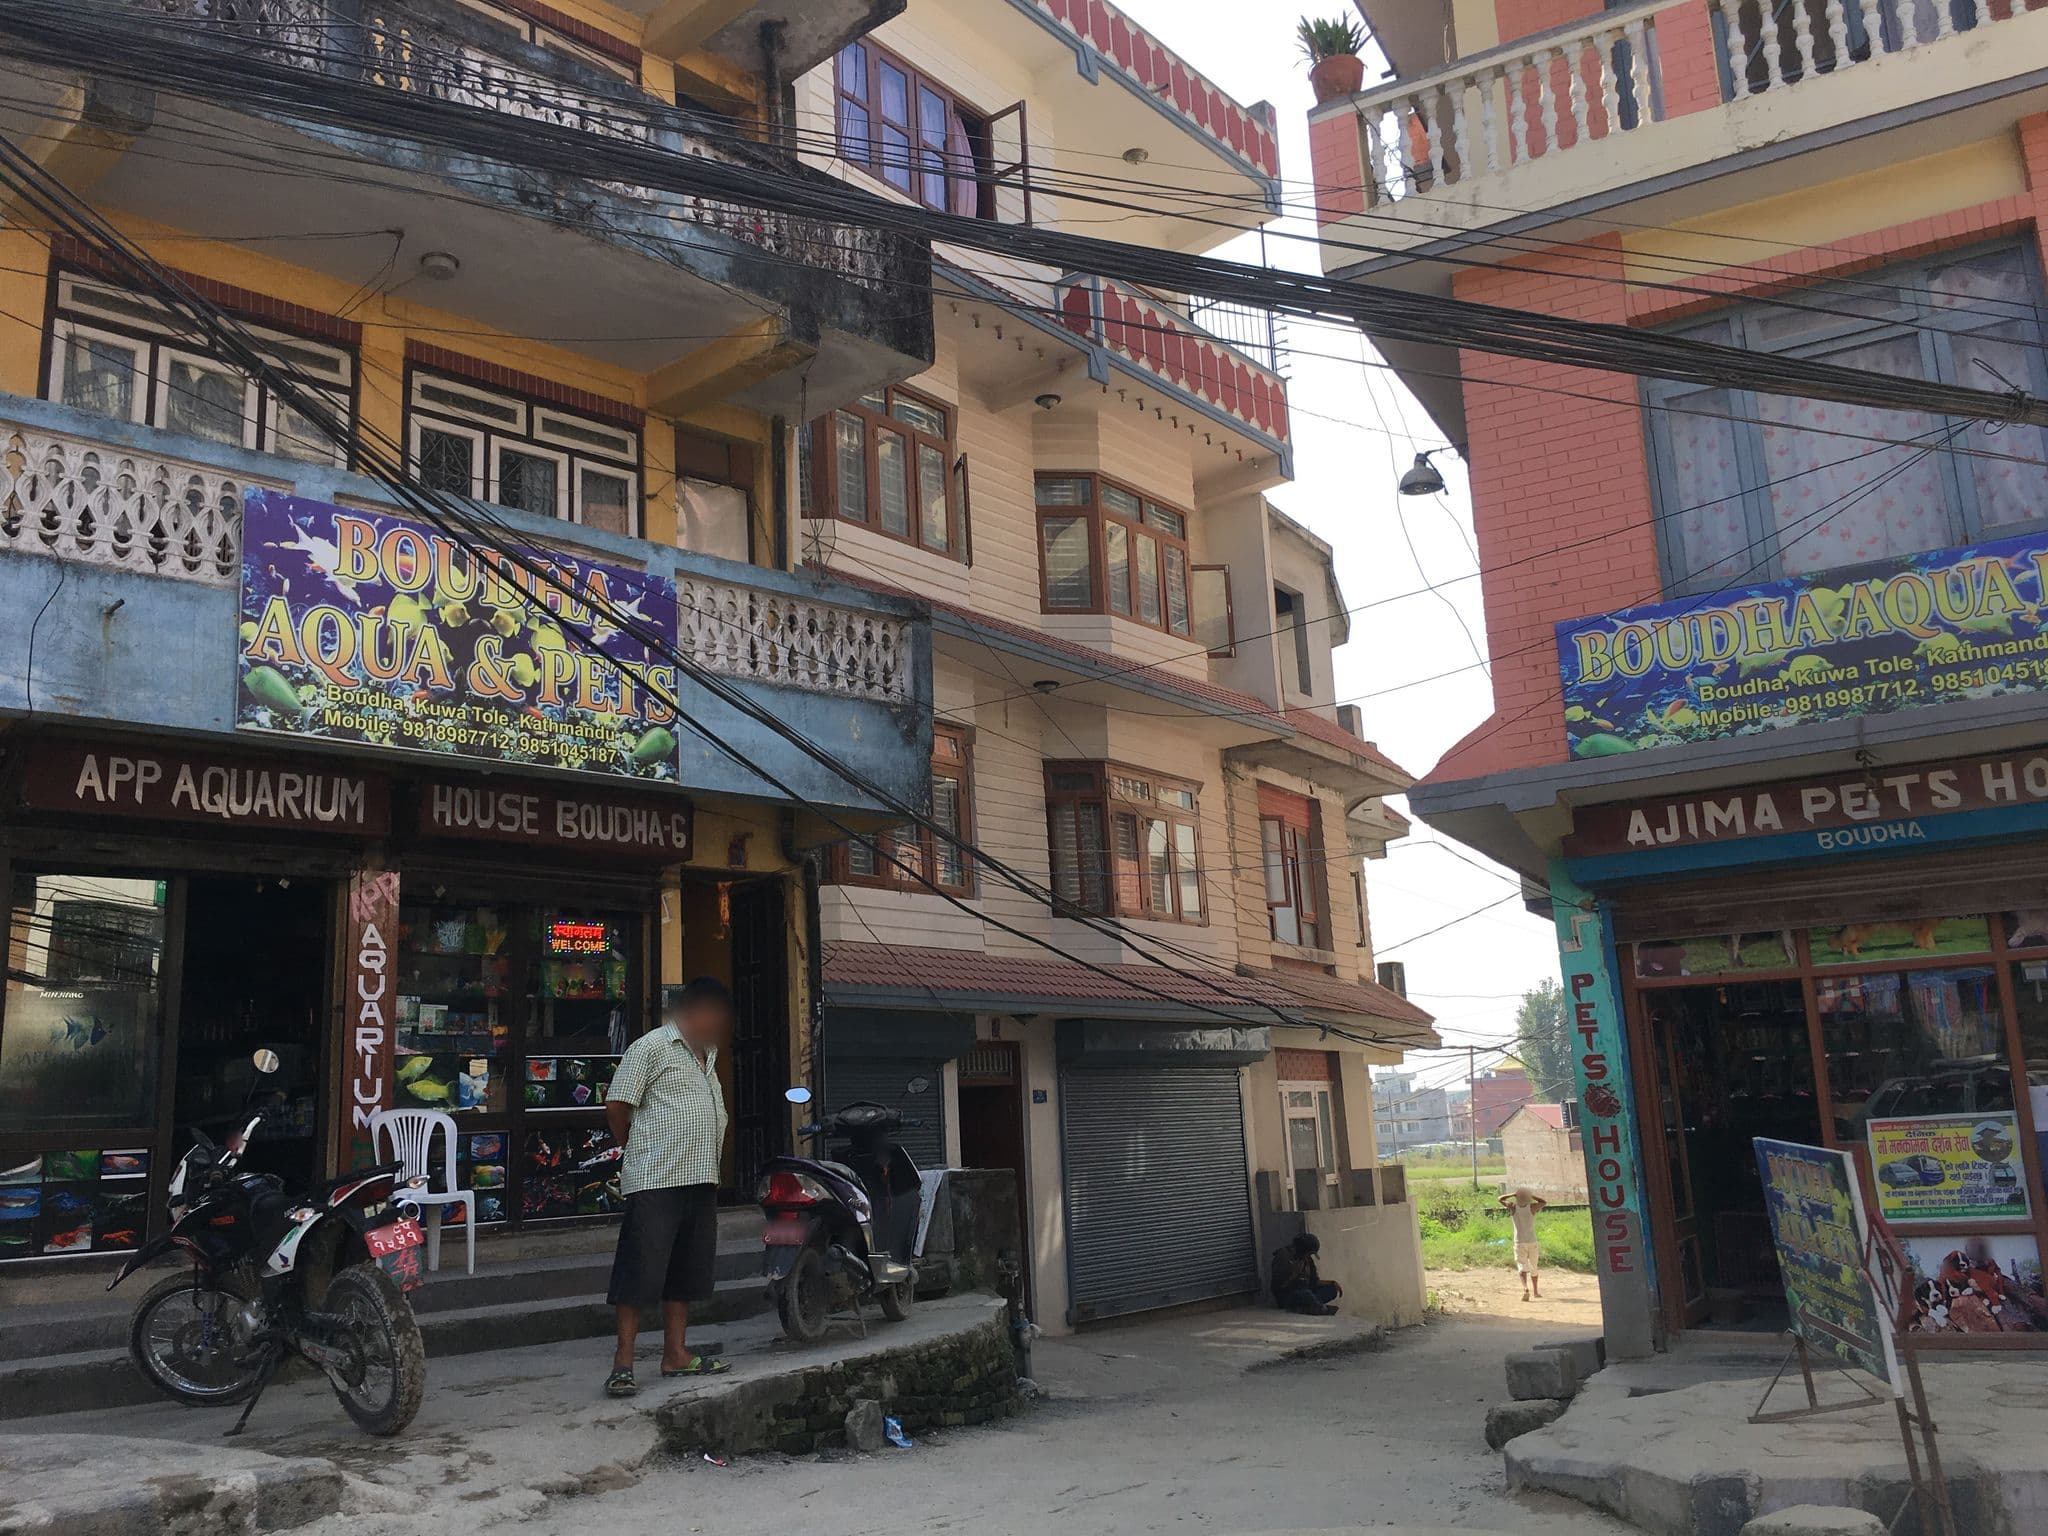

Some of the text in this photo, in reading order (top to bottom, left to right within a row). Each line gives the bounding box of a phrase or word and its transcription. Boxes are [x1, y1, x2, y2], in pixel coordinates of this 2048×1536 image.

[332, 513, 626, 630] BOUDHA
[1574, 595, 1835, 684] BOUDHA
[1843, 559, 2026, 642] AQUA
[246, 597, 678, 725] AQUA & PETS
[1700, 674, 1791, 703] Boudha,
[1797, 663, 1860, 688] Kuwa
[1865, 653, 1920, 678] Tole,
[324, 709, 618, 764] Mobile: 9818987712, 9851045187
[326, 686, 617, 743] Boudha, Kuwa Tole, Kathmandu
[1700, 702, 1782, 727] Mobile:
[1784, 677, 1927, 716] 9818987712,
[75, 754, 365, 824] APP AQUARIUM
[432, 784, 540, 835] HOUSE
[1626, 792, 1784, 847] AJIMA
[1800, 770, 1962, 826] PETS
[1817, 820, 1926, 851] BOUDHA
[552, 939, 606, 951] WELCOME
[352, 922, 387, 1132] AQUARIUM
[1570, 973, 1608, 1081] PETS
[1591, 1123, 1634, 1274] HOUSE
